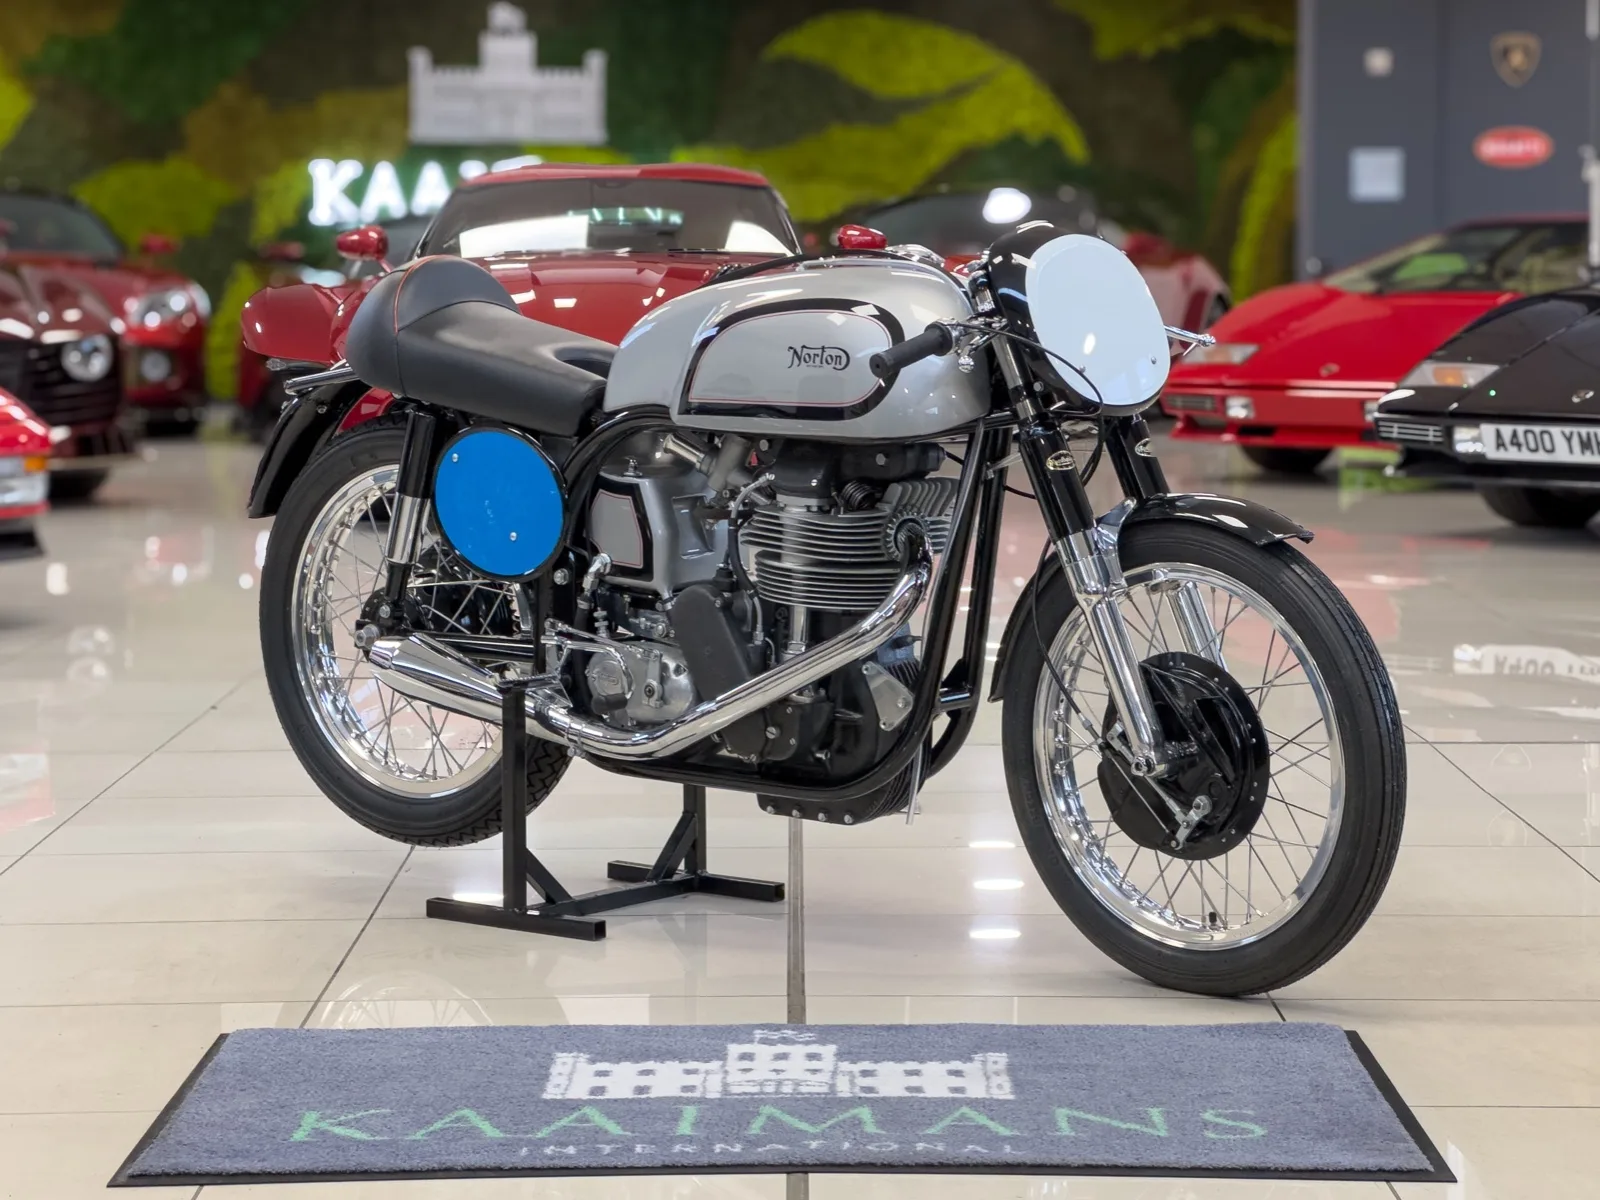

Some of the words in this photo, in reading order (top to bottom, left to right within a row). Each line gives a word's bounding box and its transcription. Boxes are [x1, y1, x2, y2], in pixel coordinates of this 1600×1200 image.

[307, 157, 543, 226] KAA
[787, 344, 851, 371] Norton
[1494, 427, 1555, 453] A400
[290, 1105, 1267, 1142] KAAIMANS
[519, 1139, 1027, 1156] INTERNATIONAL
